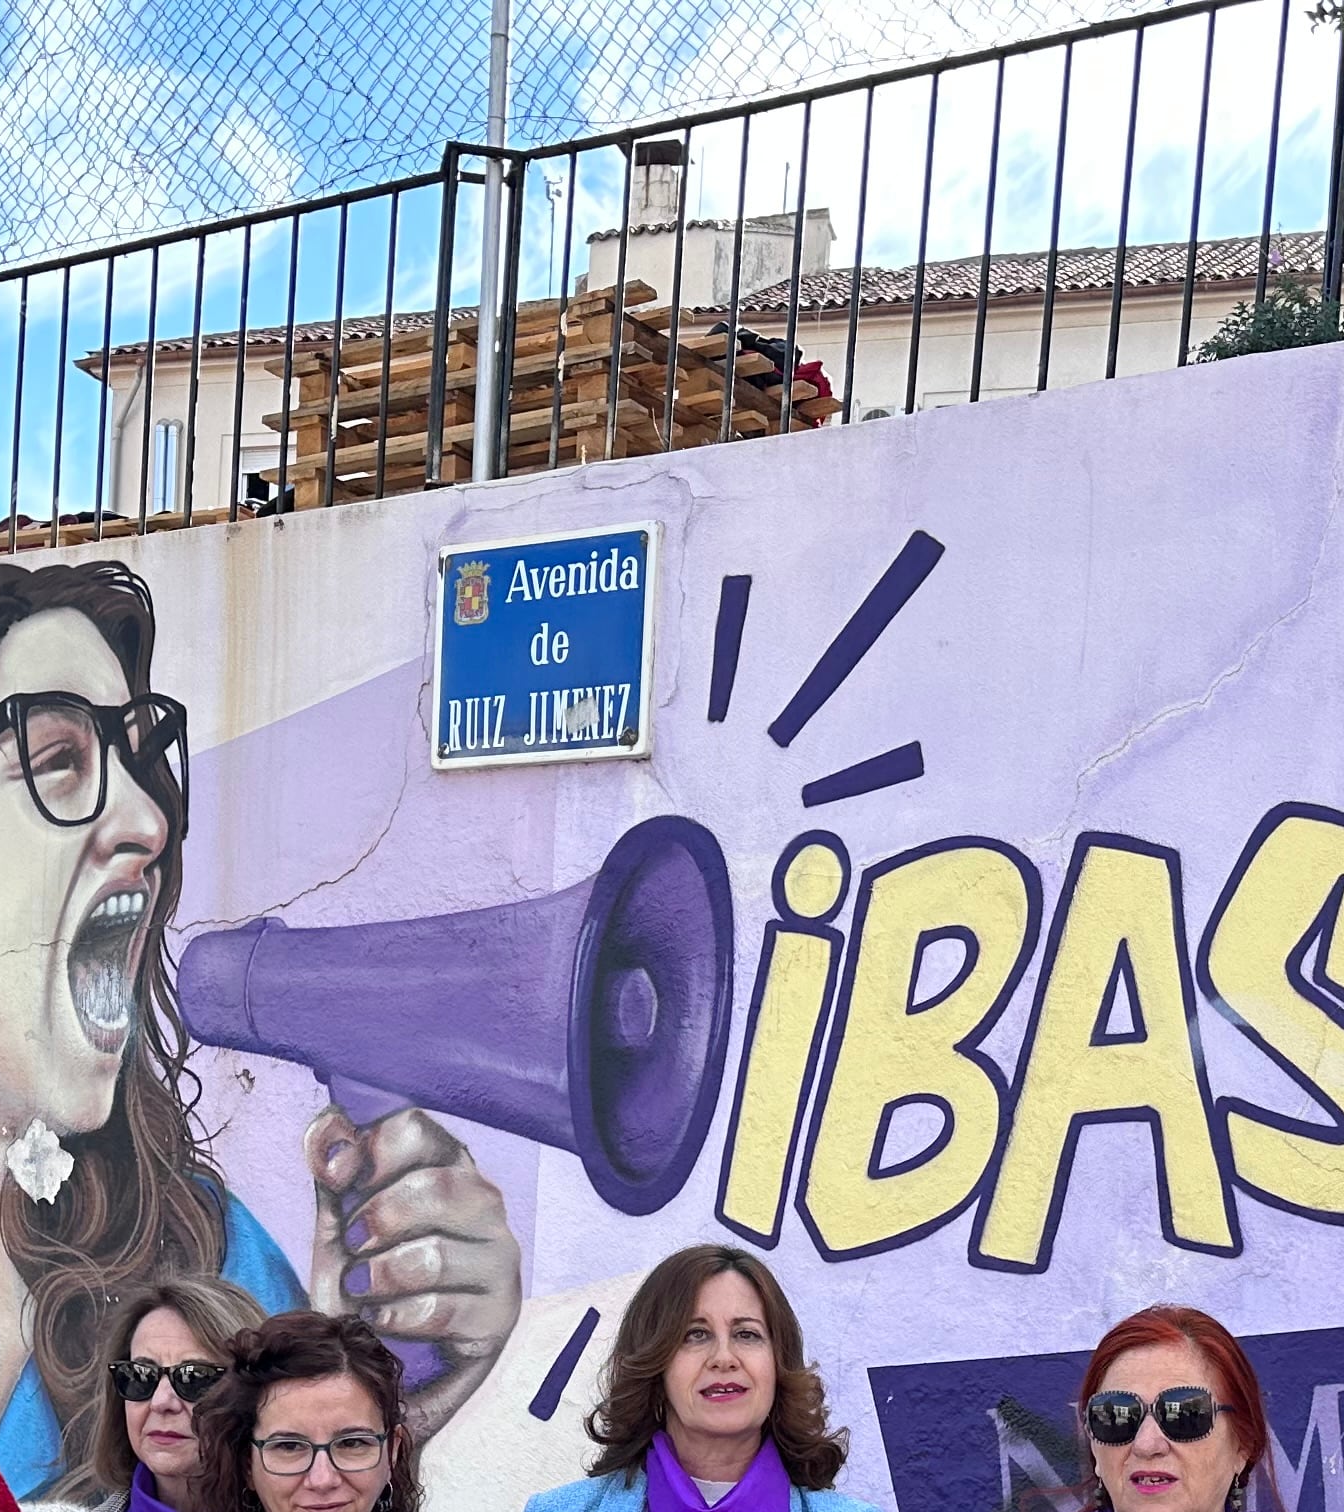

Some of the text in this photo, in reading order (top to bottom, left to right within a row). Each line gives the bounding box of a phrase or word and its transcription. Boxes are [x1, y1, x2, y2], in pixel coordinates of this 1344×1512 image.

[506, 548, 640, 603] Avenida
[530, 622, 570, 666] de
[448, 694, 507, 752] RUIZ
